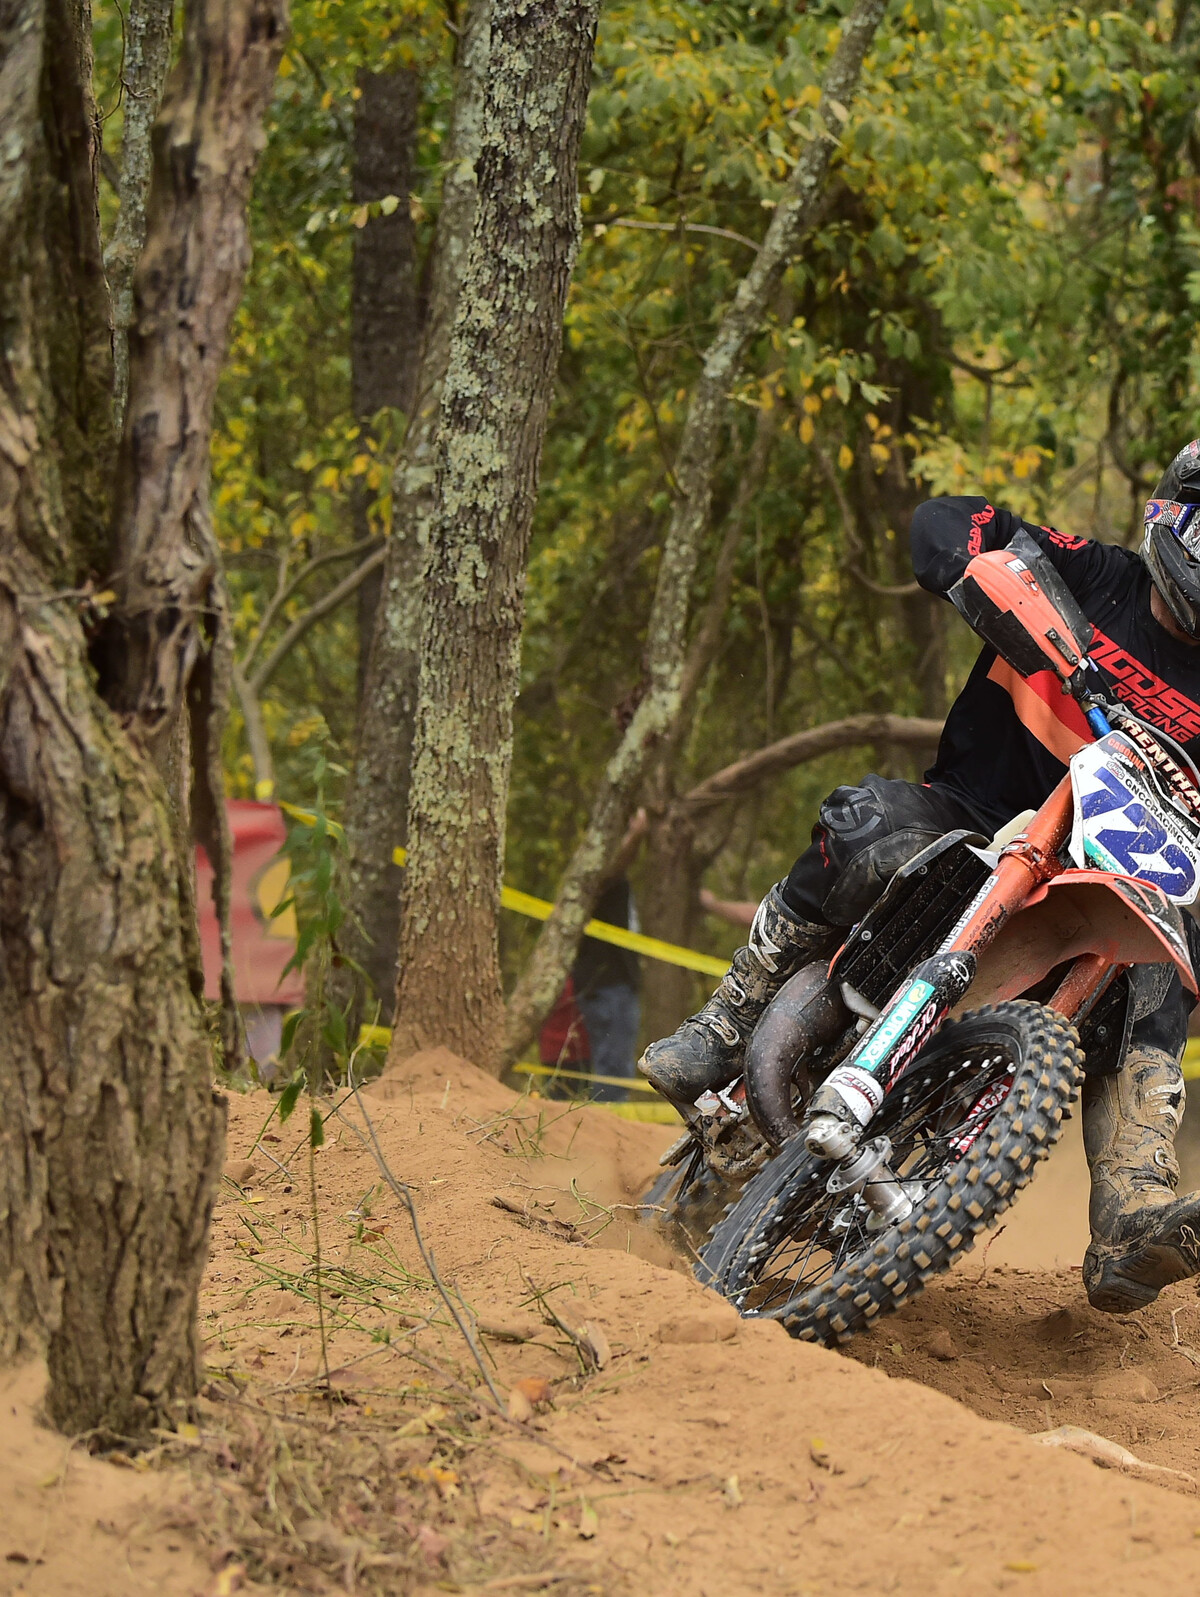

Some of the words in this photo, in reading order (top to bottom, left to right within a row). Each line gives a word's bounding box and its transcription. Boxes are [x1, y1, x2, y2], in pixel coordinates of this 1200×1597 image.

[1172, 505, 1187, 529] OAKLEY
[1111, 682, 1195, 744] RACING
[1107, 737, 1144, 770] CAROLINA
[1081, 767, 1196, 897] 722
[1124, 777, 1198, 863] GNCCRACING.COM
[863, 1000, 916, 1065] MOTOREX
